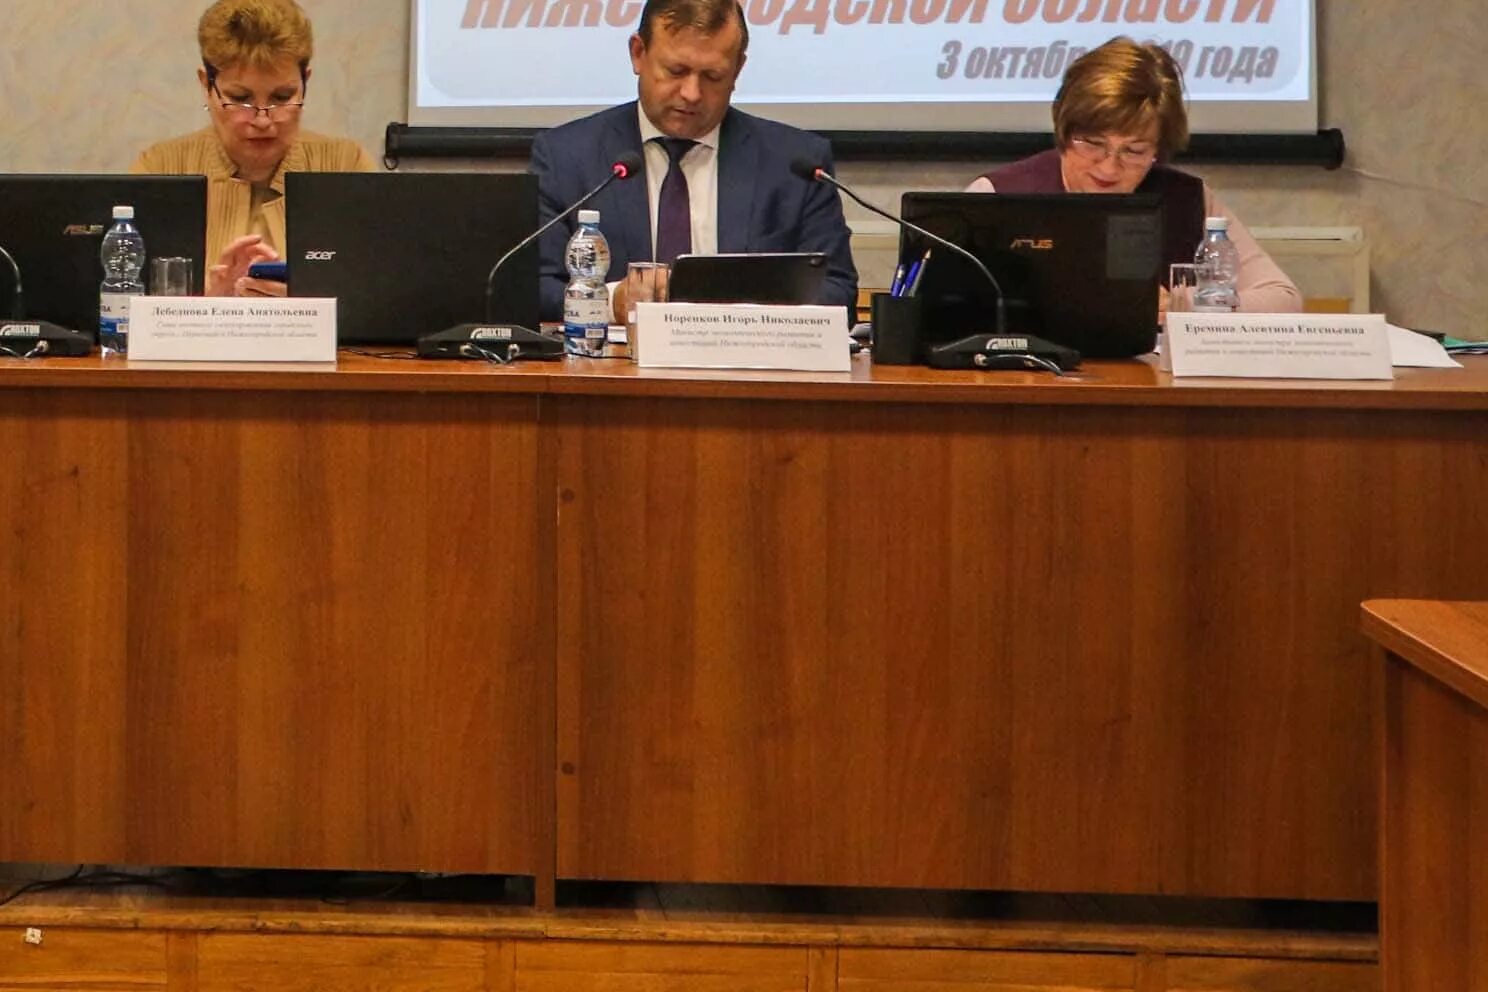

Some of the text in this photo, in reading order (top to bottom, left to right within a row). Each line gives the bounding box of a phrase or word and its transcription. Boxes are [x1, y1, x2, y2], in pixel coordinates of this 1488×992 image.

[936, 39, 962, 80] 3
[963, 39, 1086, 80] октяб
[1194, 45, 1279, 85] года
[305, 250, 337, 261] acer
